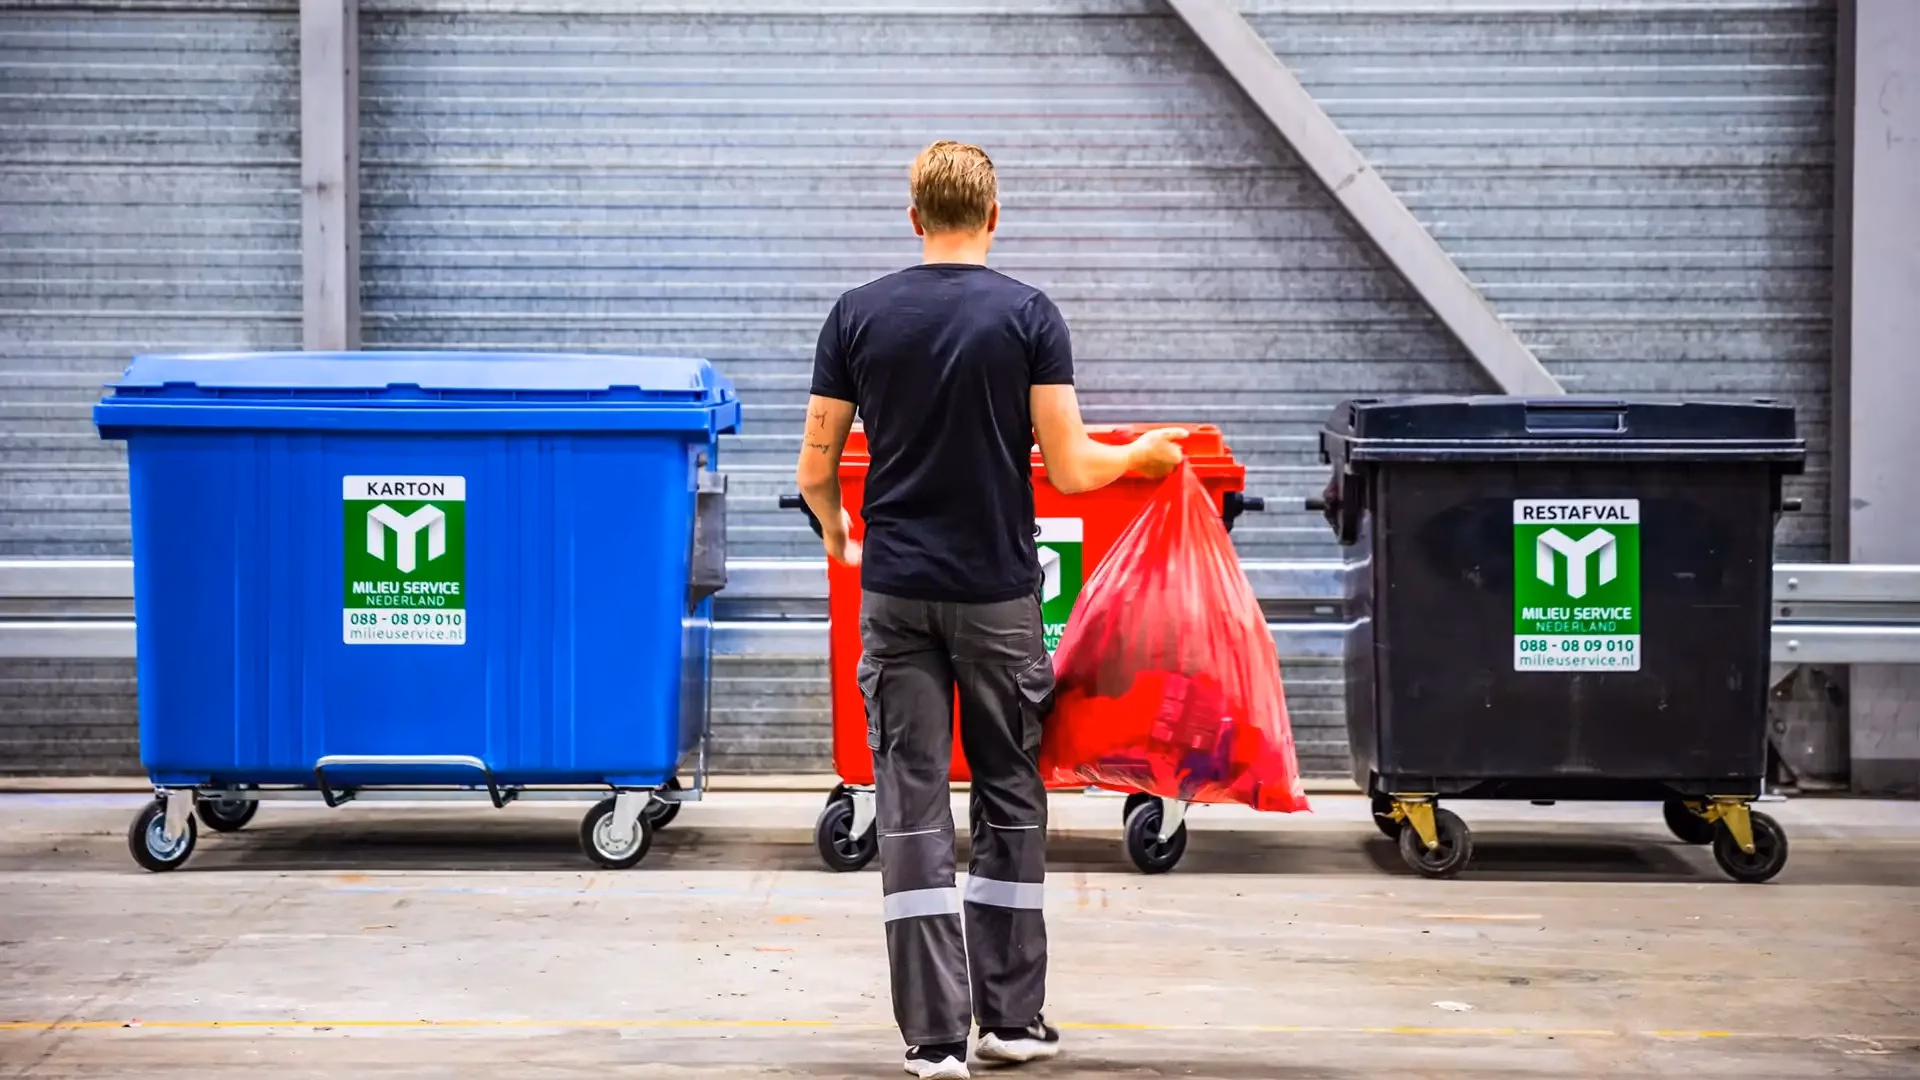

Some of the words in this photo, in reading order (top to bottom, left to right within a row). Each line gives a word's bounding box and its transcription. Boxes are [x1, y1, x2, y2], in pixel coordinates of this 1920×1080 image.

[367, 482, 445, 496] KARTON
[1523, 506, 1630, 520] RESTAFVAL
[352, 581, 400, 594] MILIEU
[402, 582, 460, 595] SERVICE
[366, 595, 446, 606] NEDERLAND
[351, 613, 377, 625] 088
[391, 613, 409, 625] 08
[413, 614, 431, 625] 09
[435, 614, 462, 625] 010
[1522, 607, 1570, 620] MILIEU
[1573, 607, 1632, 620] SERVICE
[1536, 621, 1617, 632] NEDERLAND
[350, 627, 463, 640] milieuservice.nl
[1520, 640, 1547, 652] 088
[1561, 640, 1579, 652] 08
[1584, 640, 1602, 652] 09
[1606, 640, 1634, 652] 010
[1520, 654, 1634, 667] milieuservice.nl
